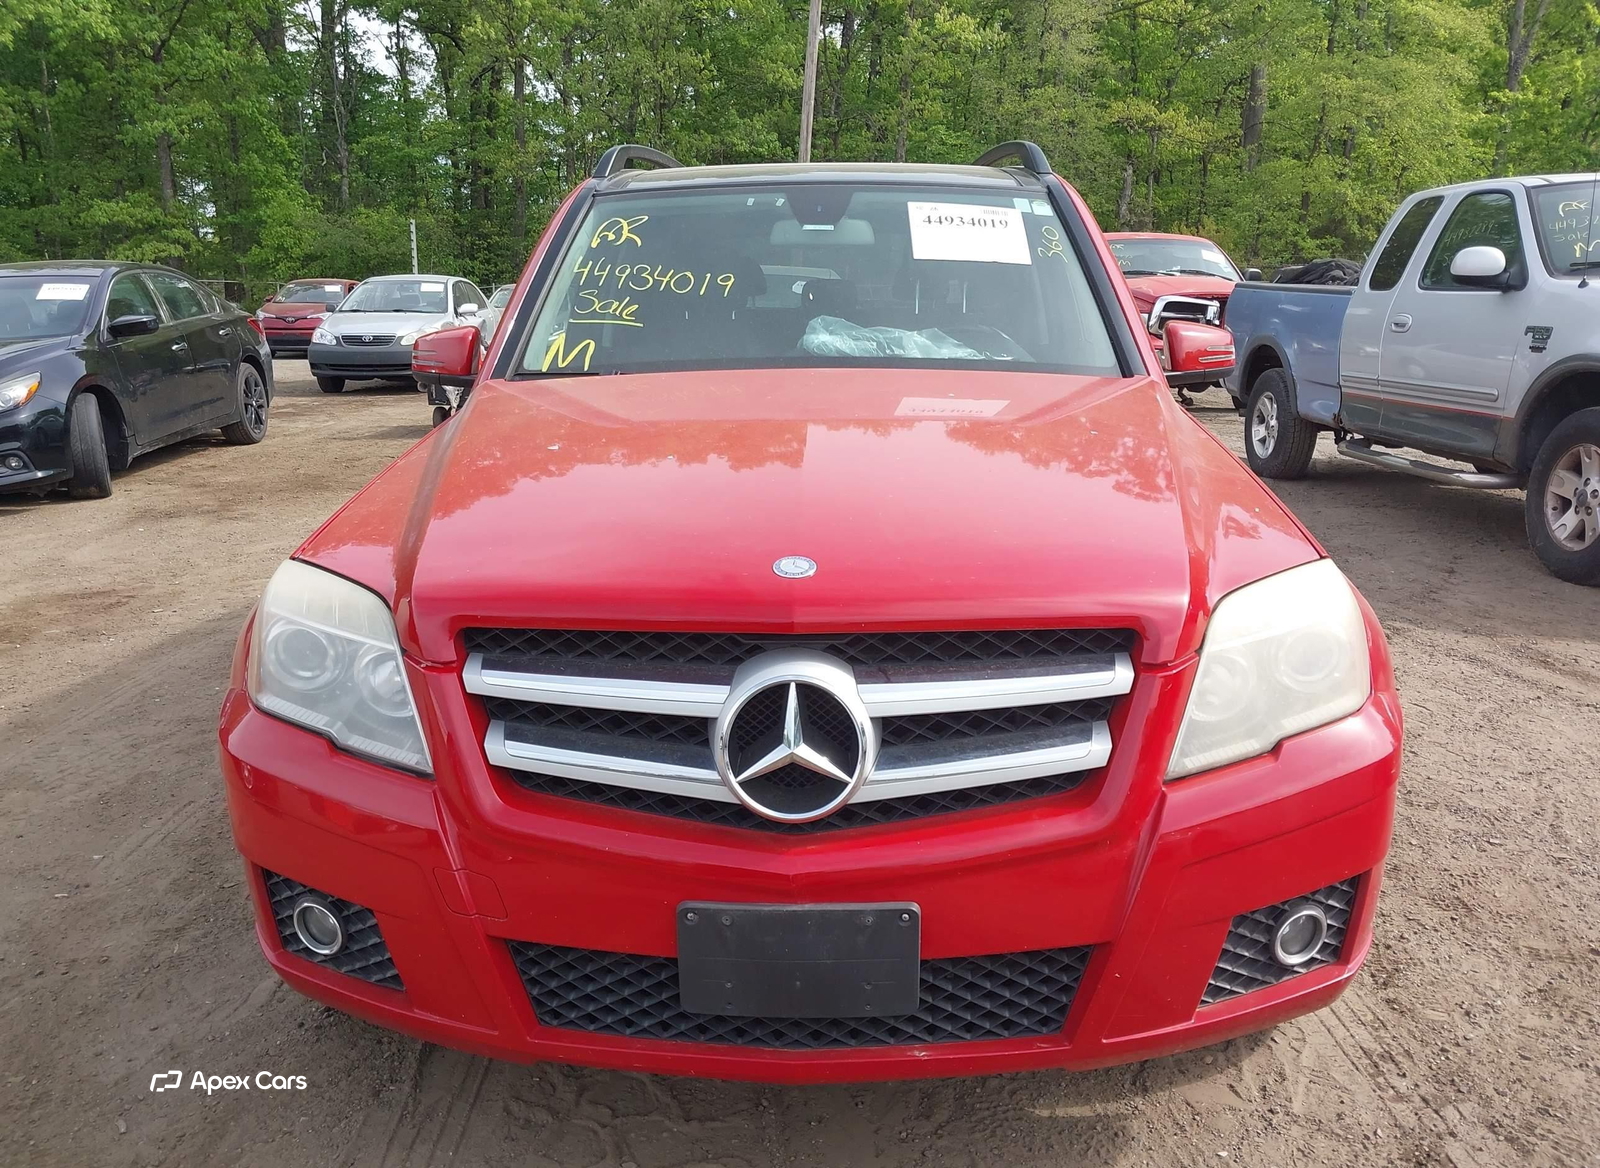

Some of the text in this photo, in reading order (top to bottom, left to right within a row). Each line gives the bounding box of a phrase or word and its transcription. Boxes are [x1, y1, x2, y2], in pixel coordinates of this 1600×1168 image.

[922, 215, 1008, 229] 44934019
[1037, 225, 1068, 263] 360
[573, 255, 735, 298] 44934019
[574, 289, 640, 320] Sale
[541, 332, 596, 372] M
